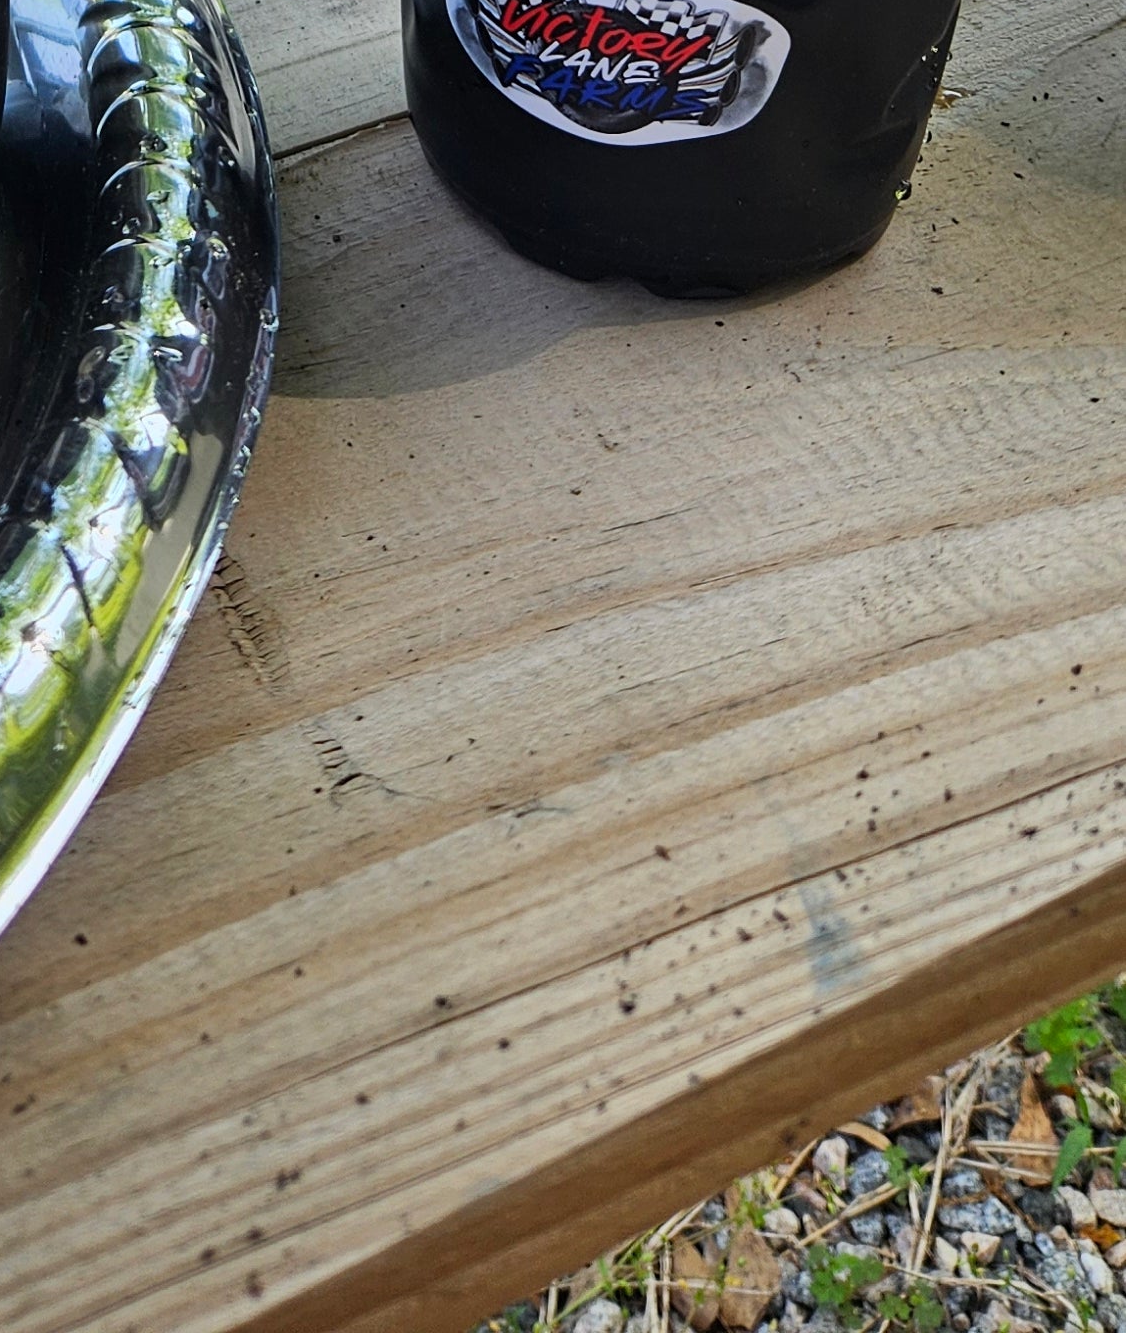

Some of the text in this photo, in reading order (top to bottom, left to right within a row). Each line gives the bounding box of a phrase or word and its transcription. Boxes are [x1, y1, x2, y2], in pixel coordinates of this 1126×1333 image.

[501, 0, 711, 72] VICTORY
[540, 41, 660, 83] LANE
[504, 53, 710, 117] FARMS
